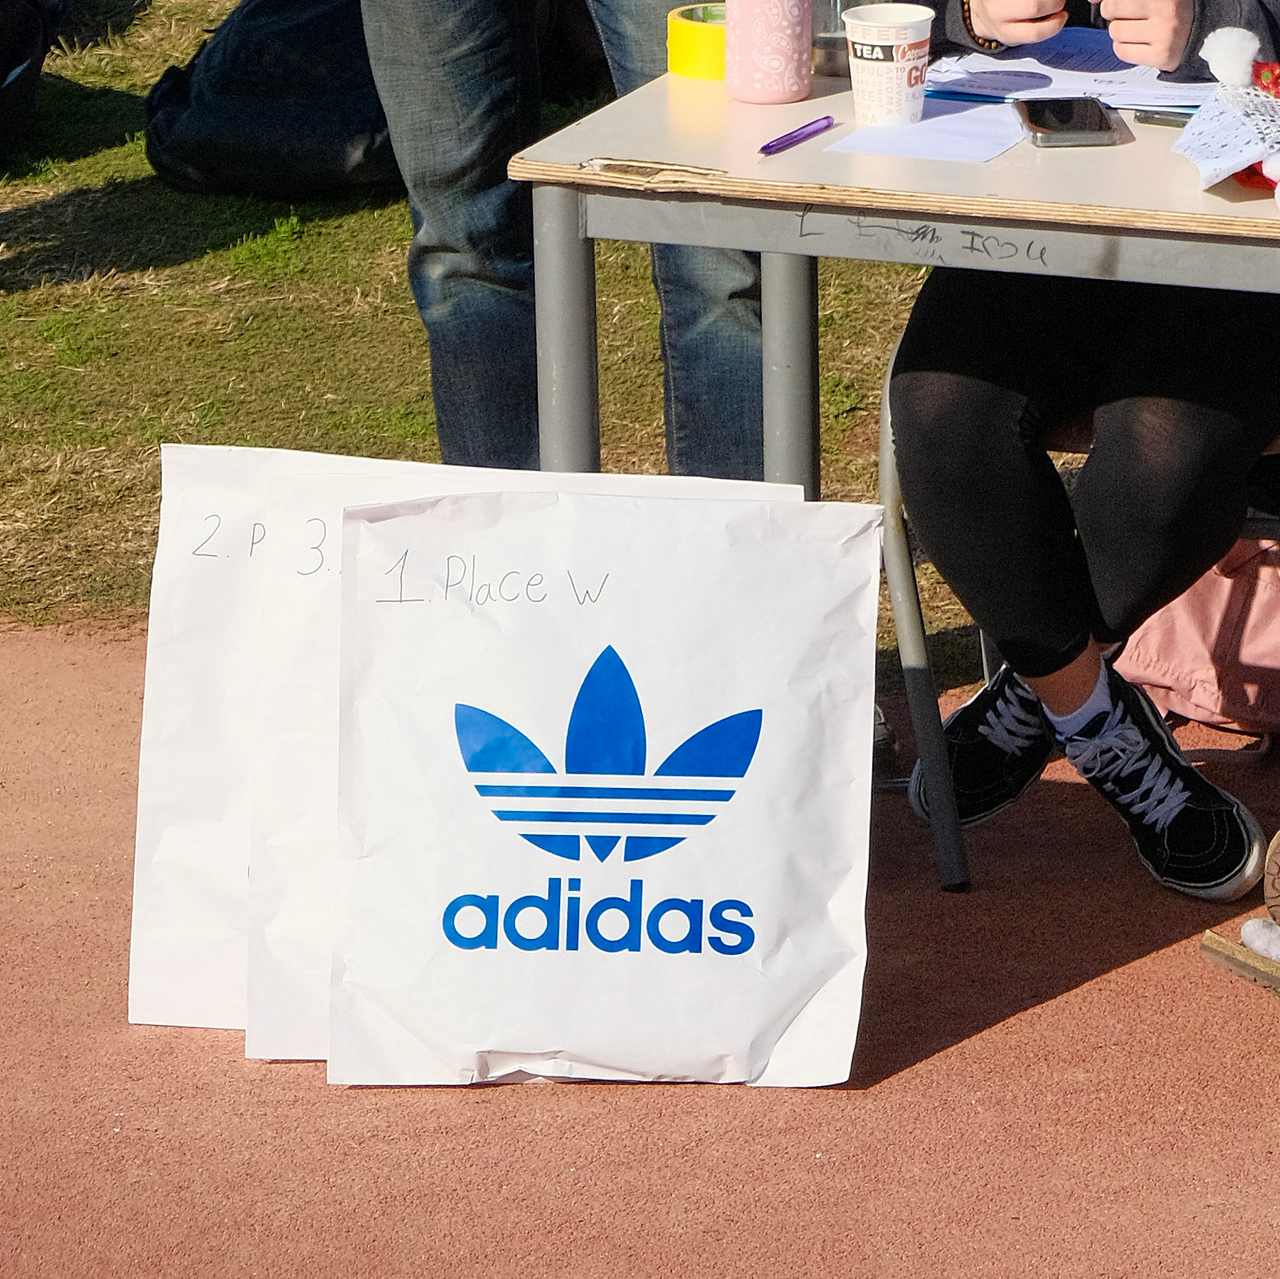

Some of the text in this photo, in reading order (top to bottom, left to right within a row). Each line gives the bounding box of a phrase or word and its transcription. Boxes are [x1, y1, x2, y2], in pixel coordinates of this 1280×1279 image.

[854, 44, 884, 59] TEA
[894, 61, 928, 89] TO GO
[191, 514, 230, 558] 2.
[376, 549, 432, 604] 1.
[444, 554, 548, 606] Place
[443, 878, 755, 955] adidas
